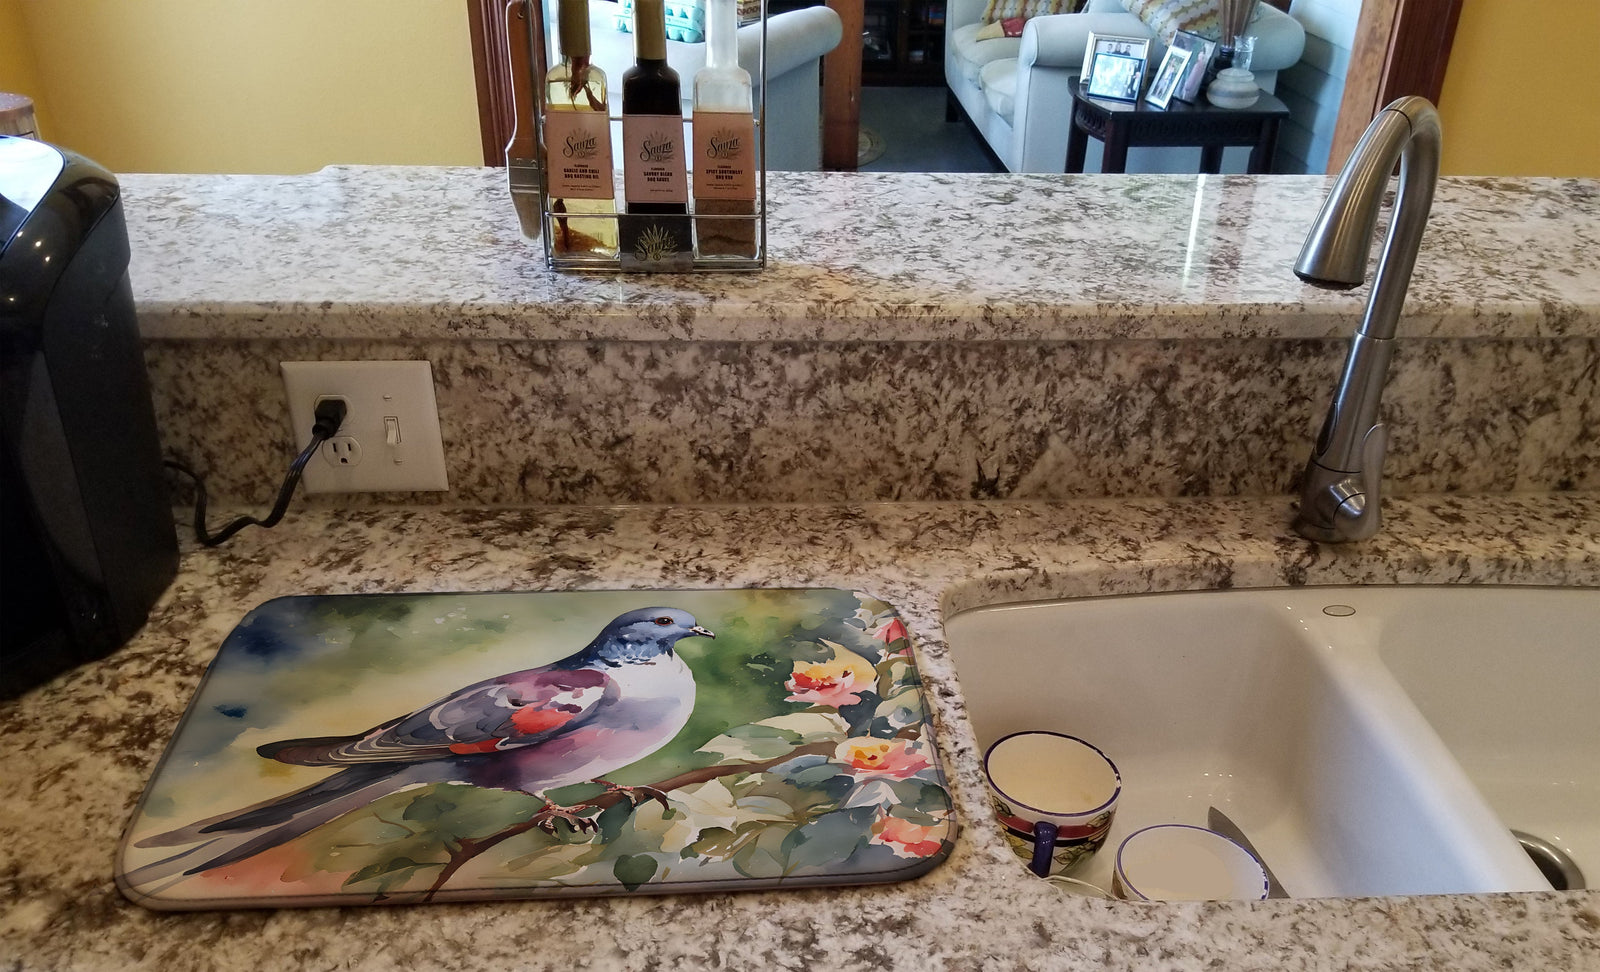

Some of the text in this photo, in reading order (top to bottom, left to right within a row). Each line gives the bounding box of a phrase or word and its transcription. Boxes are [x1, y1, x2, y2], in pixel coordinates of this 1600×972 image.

[563, 136, 597, 158] Sauza
[640, 140, 673, 162] Sauza
[707, 137, 740, 159] Sauza
